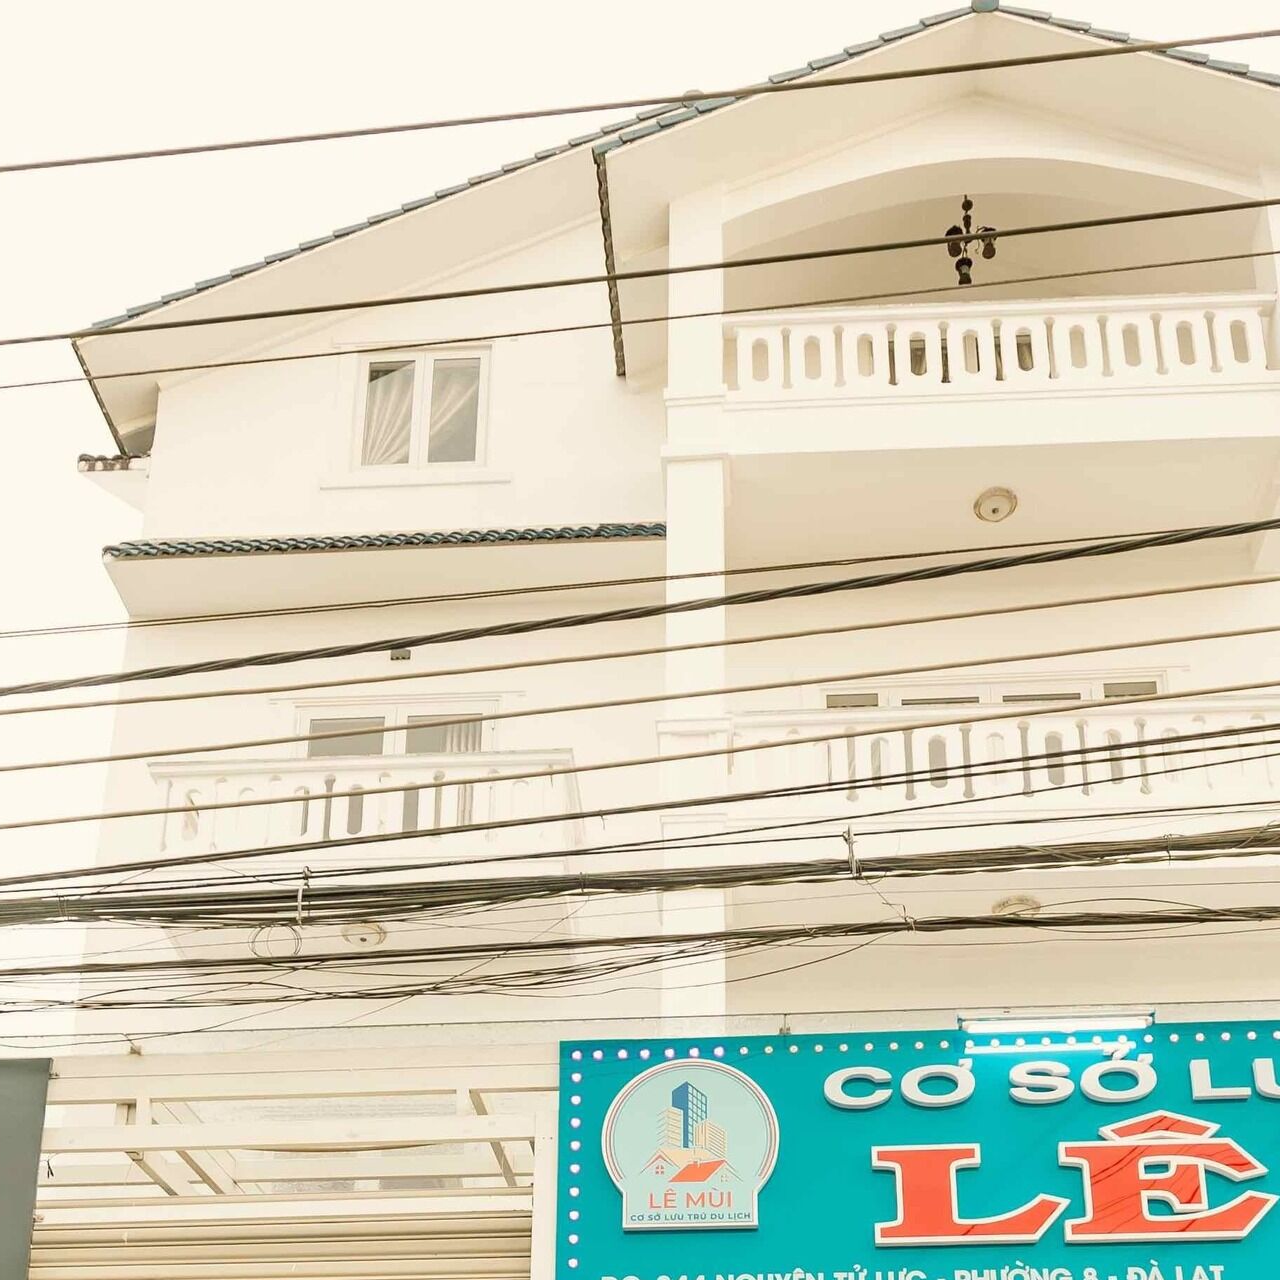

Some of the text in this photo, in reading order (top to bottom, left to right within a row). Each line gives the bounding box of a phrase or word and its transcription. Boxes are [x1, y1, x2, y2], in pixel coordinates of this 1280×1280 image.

[824, 1058, 976, 1109] CƠ
[1009, 1046, 1158, 1104] SỞ
[649, 1187, 733, 1209] LÊ MÙI
[870, 1110, 1280, 1247] LÊ
[710, 1212, 725, 1220] DU
[727, 1212, 751, 1222] LỊCH
